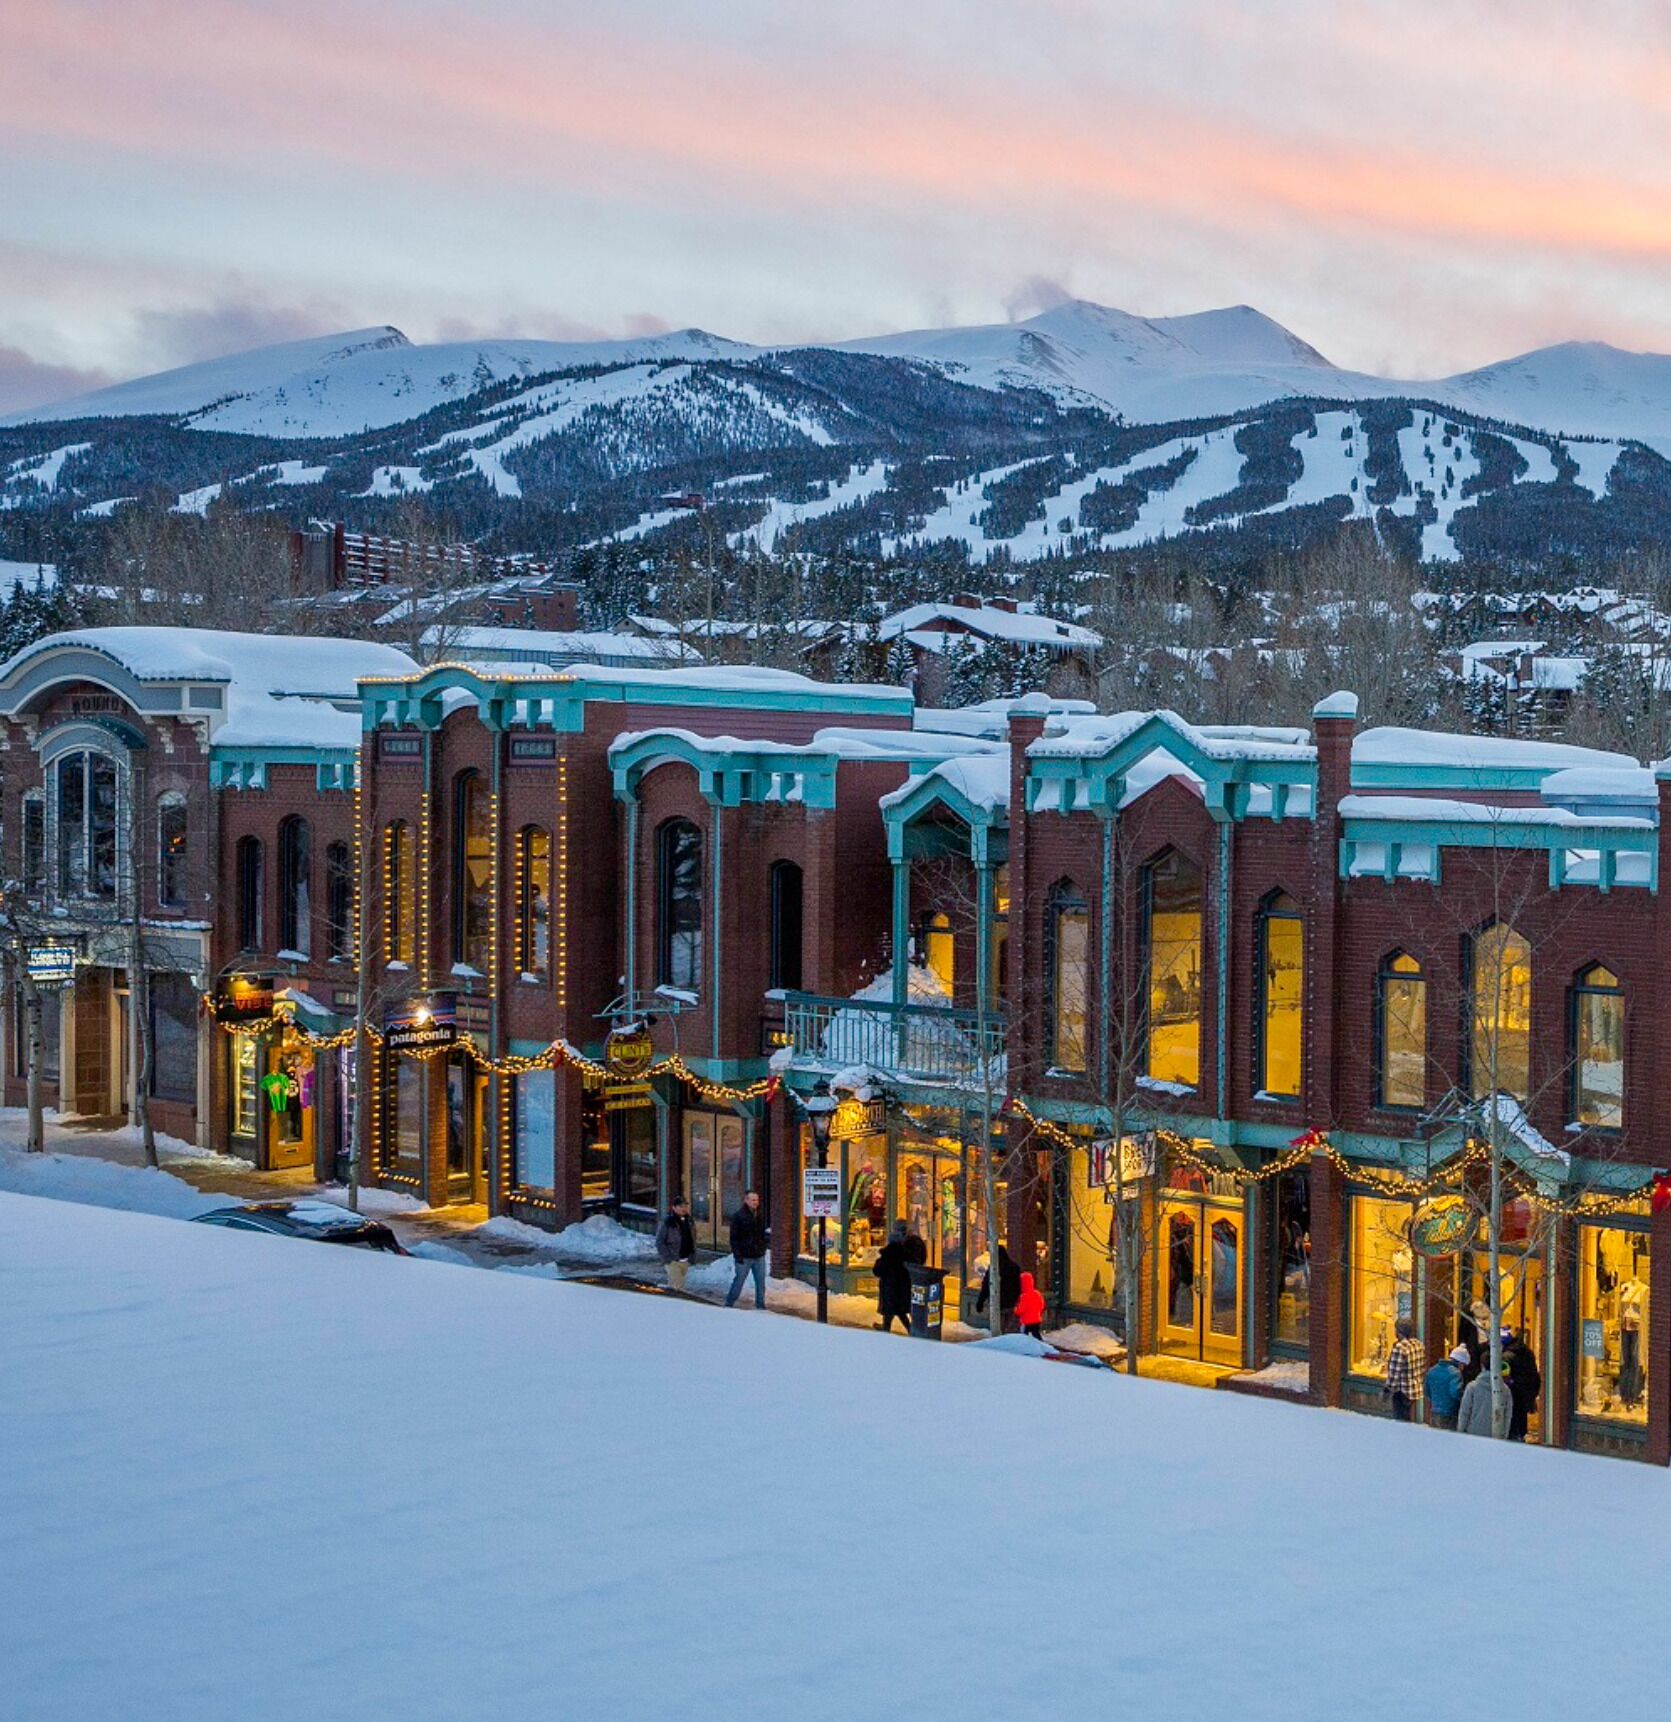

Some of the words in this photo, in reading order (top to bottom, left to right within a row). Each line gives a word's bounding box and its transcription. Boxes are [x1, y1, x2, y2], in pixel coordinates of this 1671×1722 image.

[390, 1028, 451, 1047] patagonia
[1583, 1330, 1603, 1340] 70%
[1583, 1338, 1603, 1348] OFF
